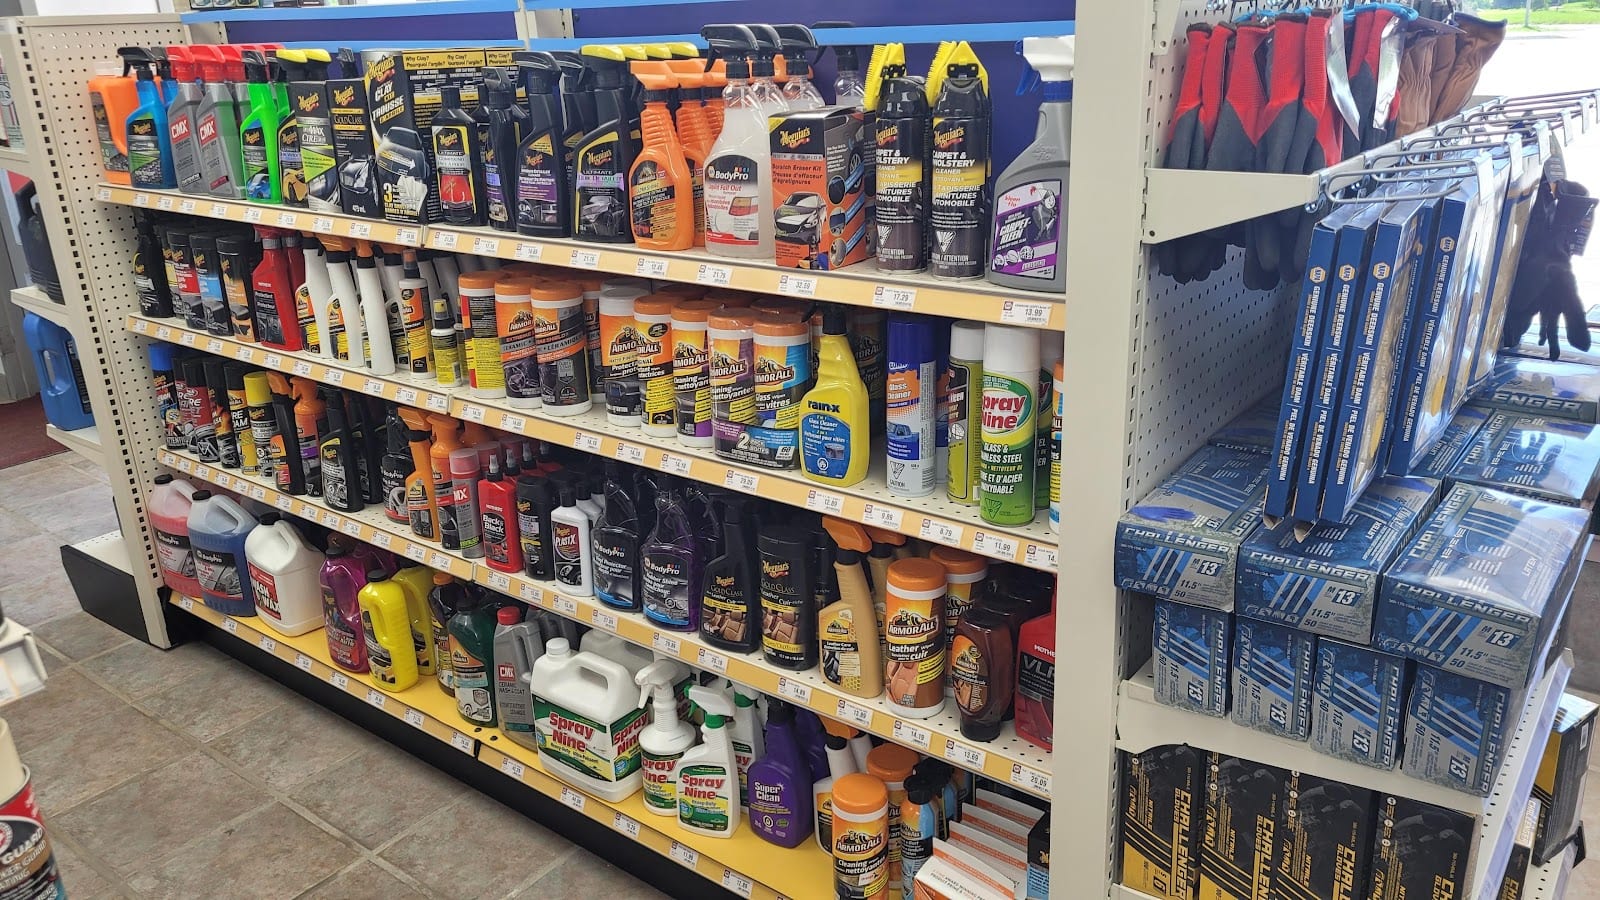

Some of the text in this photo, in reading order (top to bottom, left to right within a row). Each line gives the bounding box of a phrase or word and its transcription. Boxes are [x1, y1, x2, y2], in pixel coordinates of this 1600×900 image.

[374, 82, 394, 101] CLAY
[372, 95, 405, 121] TROUSSE
[171, 119, 189, 138] CMX
[199, 120, 215, 139] CMX
[780, 127, 811, 148] Meguiar's
[960, 151, 967, 160] &
[715, 170, 748, 180] BodyPro
[383, 183, 393, 202] 3
[1431, 254, 1450, 313] GENUINE DEERSKIN
[1310, 286, 1320, 315] GENUINE
[1333, 284, 1350, 347] GENUINE DEERSKIN
[1366, 282, 1385, 346] GENUINE DEERSKIN
[1304, 315, 1316, 346] DEERSKIN
[1419, 351, 1428, 368] DAIM
[1415, 371, 1424, 385] PIEL
[981, 395, 1027, 413] pray
[1294, 388, 1303, 403] DAIM
[1323, 388, 1331, 404] DAIM
[1354, 387, 1363, 404] DAIM
[1290, 408, 1298, 421] PIEL
[1408, 394, 1420, 418] VENADO
[820, 419, 838, 427] Cleaner
[1319, 410, 1328, 423] PIEL
[1349, 410, 1359, 423] PIEL
[1405, 418, 1414, 442] GENUINA
[737, 433, 748, 450] 2
[1283, 432, 1294, 456] VENADO
[1313, 434, 1323, 458] VENADO
[1343, 434, 1354, 459] VENADO
[1001, 453, 1022, 464] STEEL
[1279, 455, 1289, 481] GENUINA
[1308, 458, 1319, 484] GENUINA
[1337, 459, 1348, 485] GENUINA
[987, 473, 1023, 483] ET D'ACIER
[453, 489, 467, 502] MX
[484, 523, 504, 534] Black
[1407, 488, 1466, 558] CHALLENGER
[1125, 527, 1231, 552] CHALLENGER
[598, 546, 625, 558] BodyPro
[650, 564, 680, 575] BodyPro
[762, 559, 789, 577] Meguiar's
[1201, 560, 1219, 575] 13
[1250, 551, 1369, 581] CHALLENGER
[1181, 579, 1201, 589] 11.5"
[1336, 589, 1356, 604] 13
[1394, 581, 1530, 623] CHALLENGER
[1311, 608, 1336, 619] 11.5"
[888, 621, 936, 636] ARMORALL
[1303, 619, 1316, 627] 50
[1491, 630, 1513, 646] 13
[889, 643, 919, 653] Leather
[910, 651, 929, 661] cuir
[1459, 647, 1488, 660] 11.5"
[1159, 656, 1167, 667] 50
[1215, 620, 1225, 712] CHALLENGER
[1450, 660, 1464, 668] 50
[499, 666, 515, 678] CMX
[1240, 675, 1248, 686] 50
[1189, 683, 1204, 702] 13
[1299, 640, 1311, 738] CHALLENGER
[1270, 703, 1286, 727] 13
[1320, 700, 1329, 713] 50
[1384, 663, 1399, 766] CHALLENGER
[549, 712, 595, 740] Spray
[613, 713, 648, 745] Spray
[1416, 722, 1425, 737] 50
[552, 729, 587, 753] Nine
[616, 735, 639, 756] Nin
[1354, 732, 1370, 754] 13
[1481, 692, 1505, 794] CHALLENGER
[642, 758, 677, 773] pray
[1450, 757, 1467, 779] 13
[682, 773, 726, 789] Spray
[754, 781, 782, 794] Super
[684, 786, 717, 799] Nine
[755, 791, 781, 803] Clean
[2, 827, 44, 865] GUARD
[836, 836, 882, 852] ARMORALL
[838, 859, 868, 868] Cleaning
